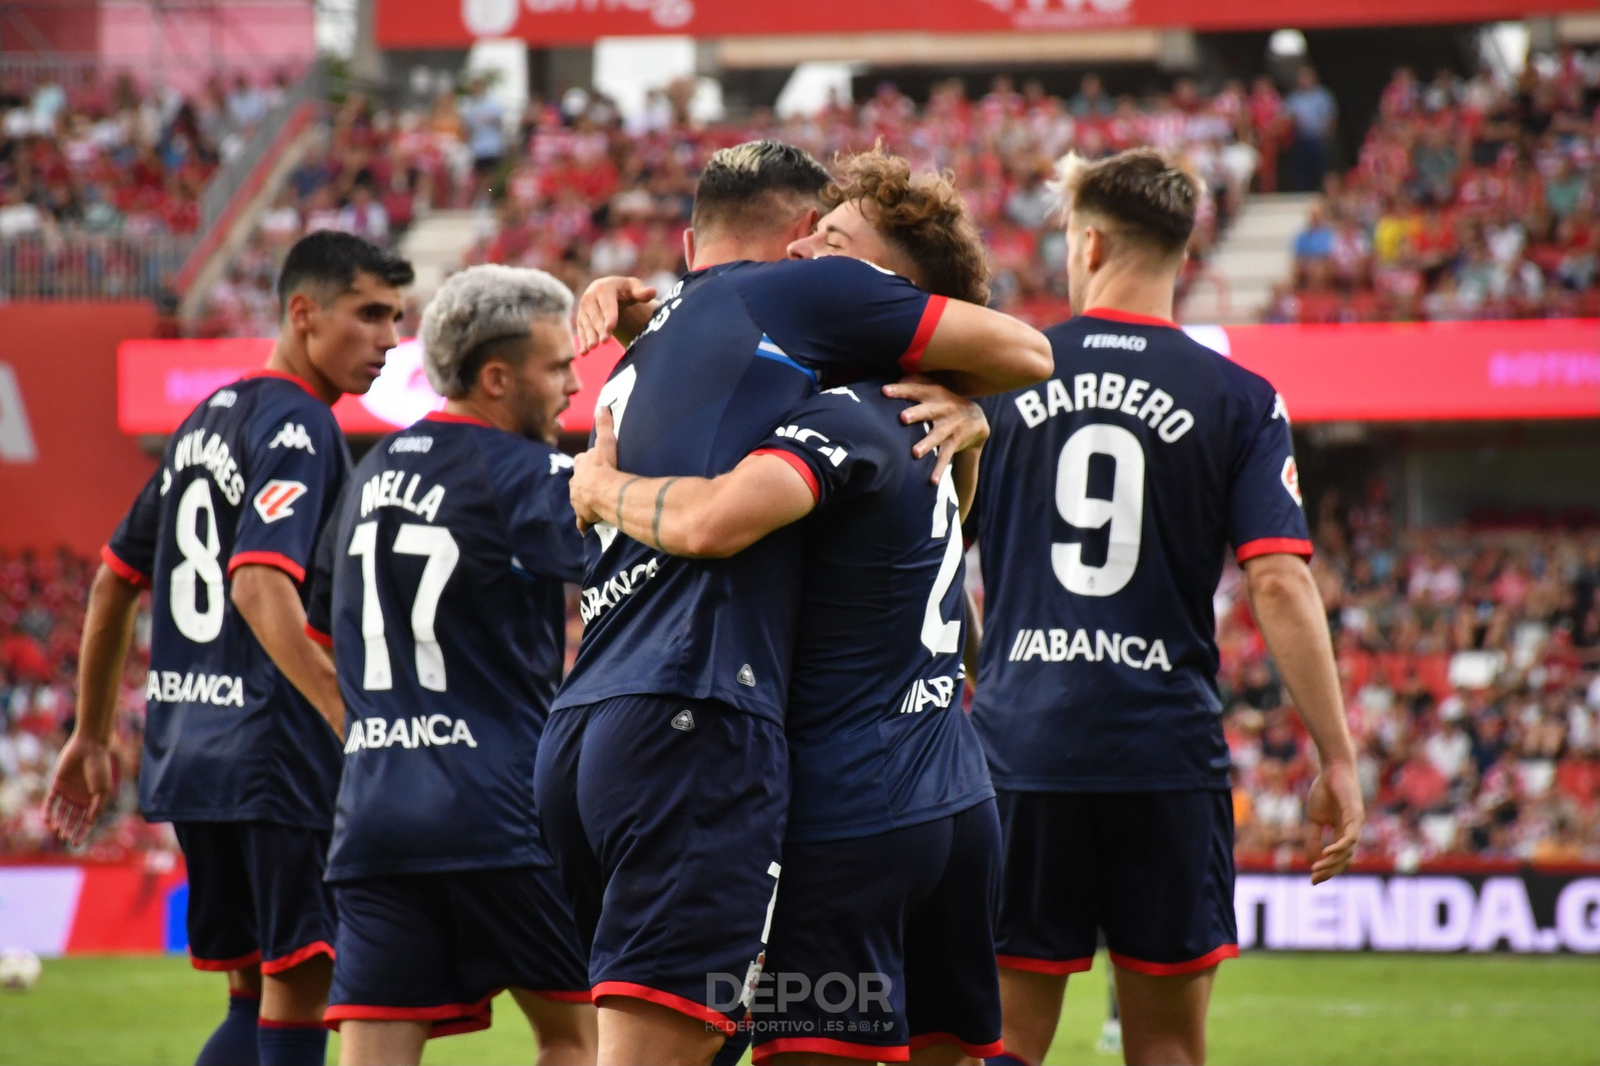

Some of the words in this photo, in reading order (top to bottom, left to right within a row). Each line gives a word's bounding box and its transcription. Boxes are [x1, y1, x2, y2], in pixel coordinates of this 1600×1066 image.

[1082, 333, 1147, 352] FEIRACO
[1015, 372, 1195, 443] BARBERO
[360, 470, 446, 522] MELLA
[1051, 423, 1145, 597] 9
[169, 478, 225, 643] 8
[348, 521, 460, 692] 17
